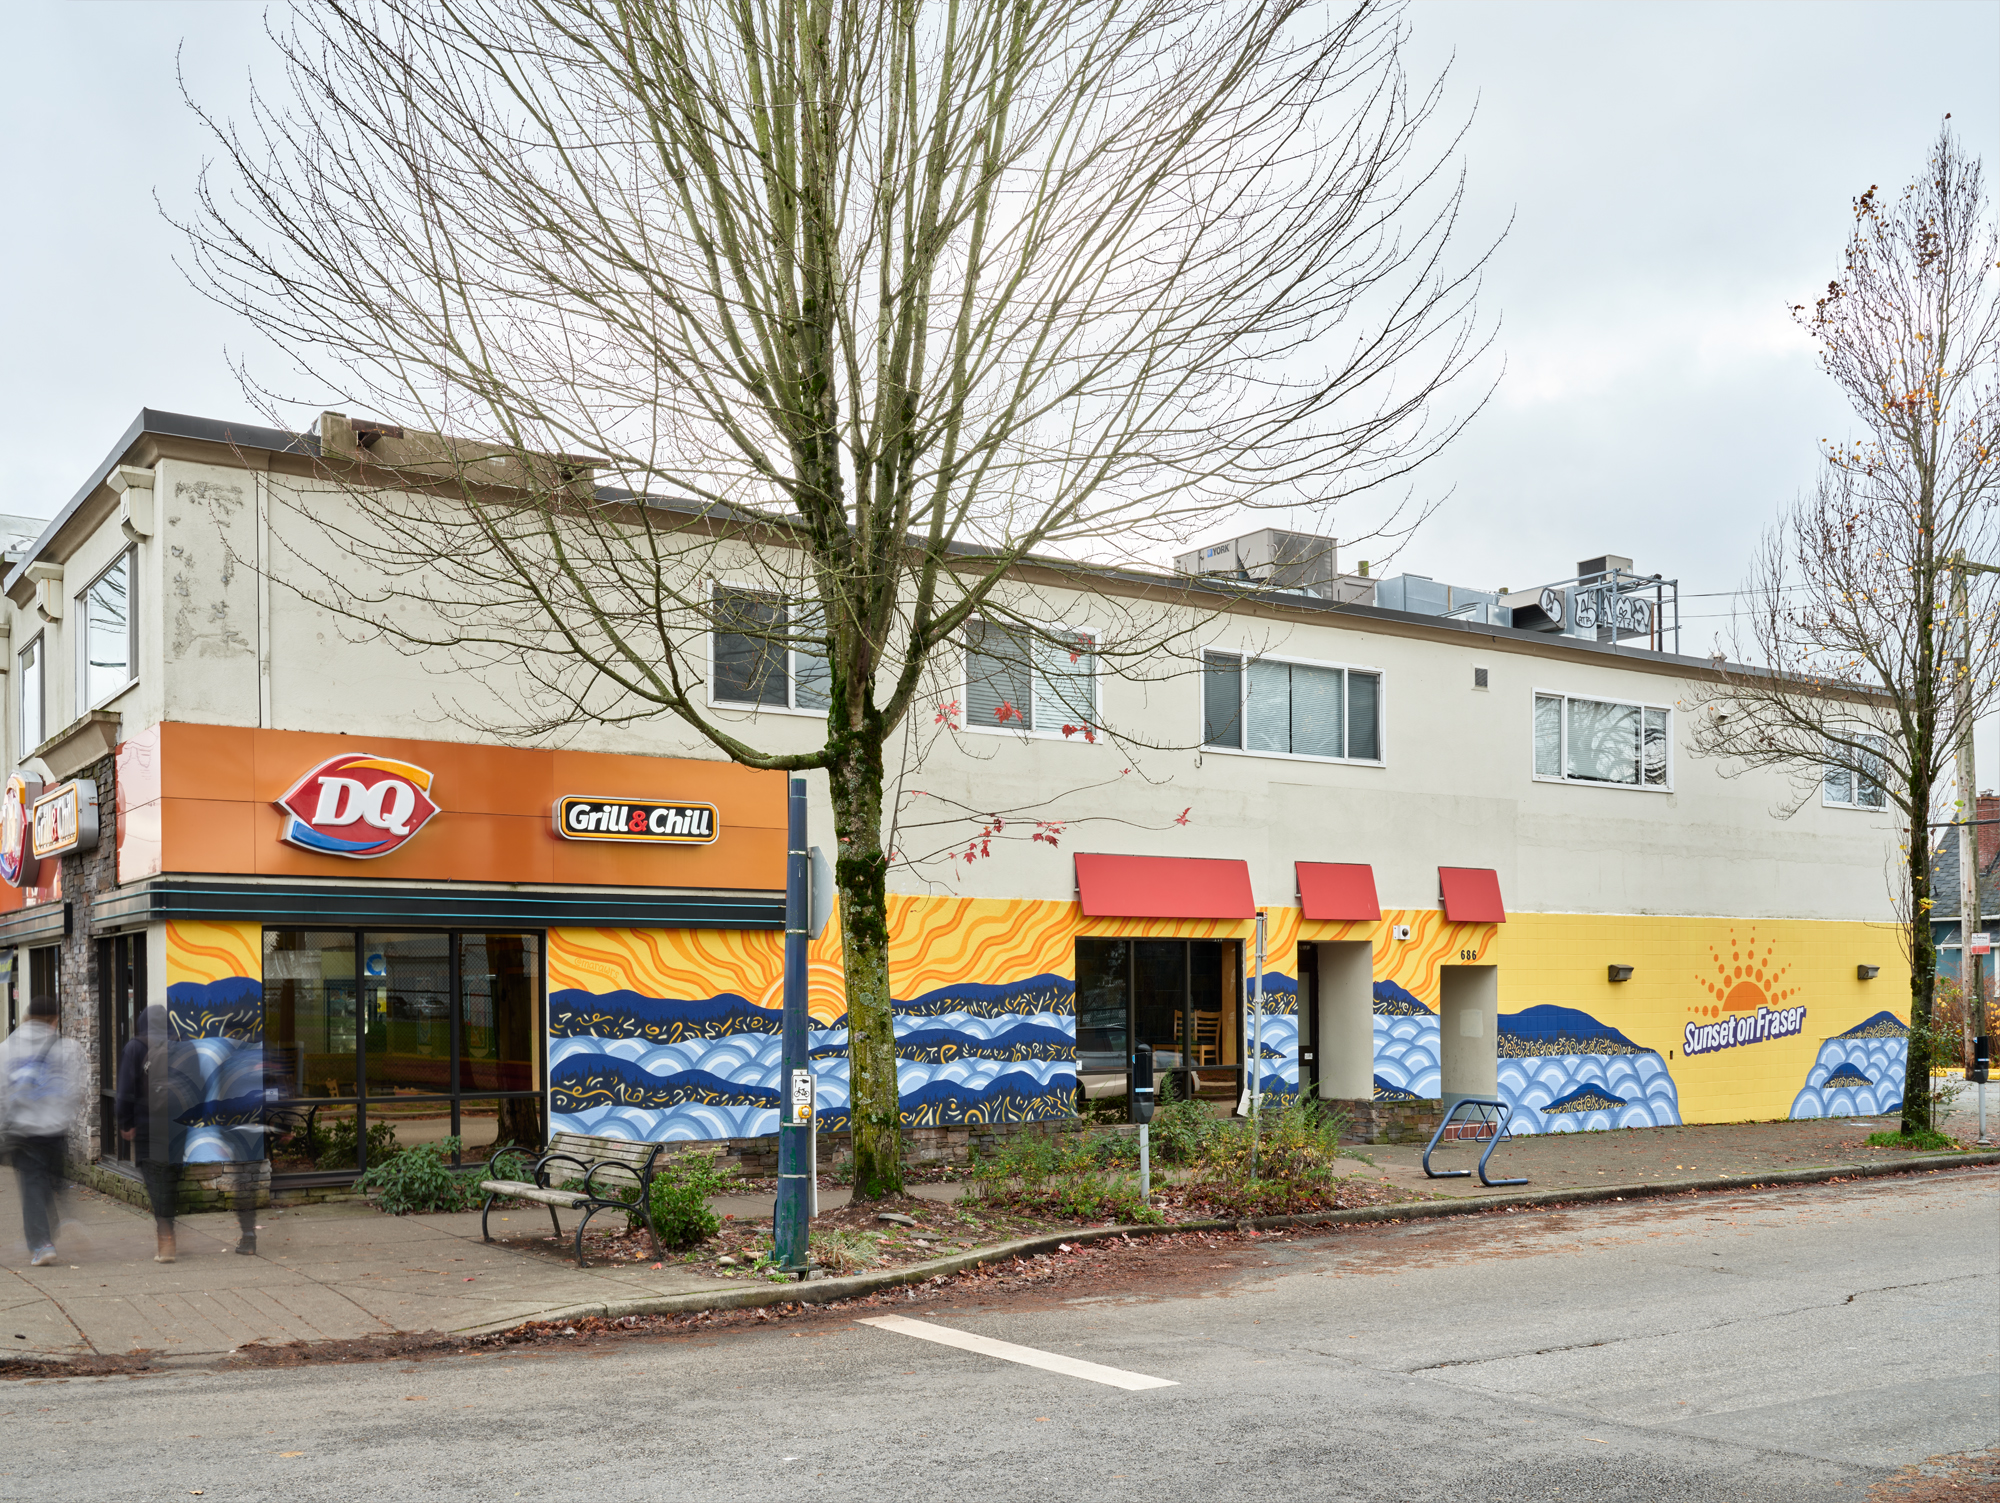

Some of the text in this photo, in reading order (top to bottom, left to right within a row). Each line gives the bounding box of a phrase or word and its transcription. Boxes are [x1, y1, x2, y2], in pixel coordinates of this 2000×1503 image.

[1213, 544, 1230, 556] YORK
[311, 776, 411, 837] DQ
[1461, 949, 1477, 960] 686
[1684, 1006, 1804, 1055] Sunset on Fraser
